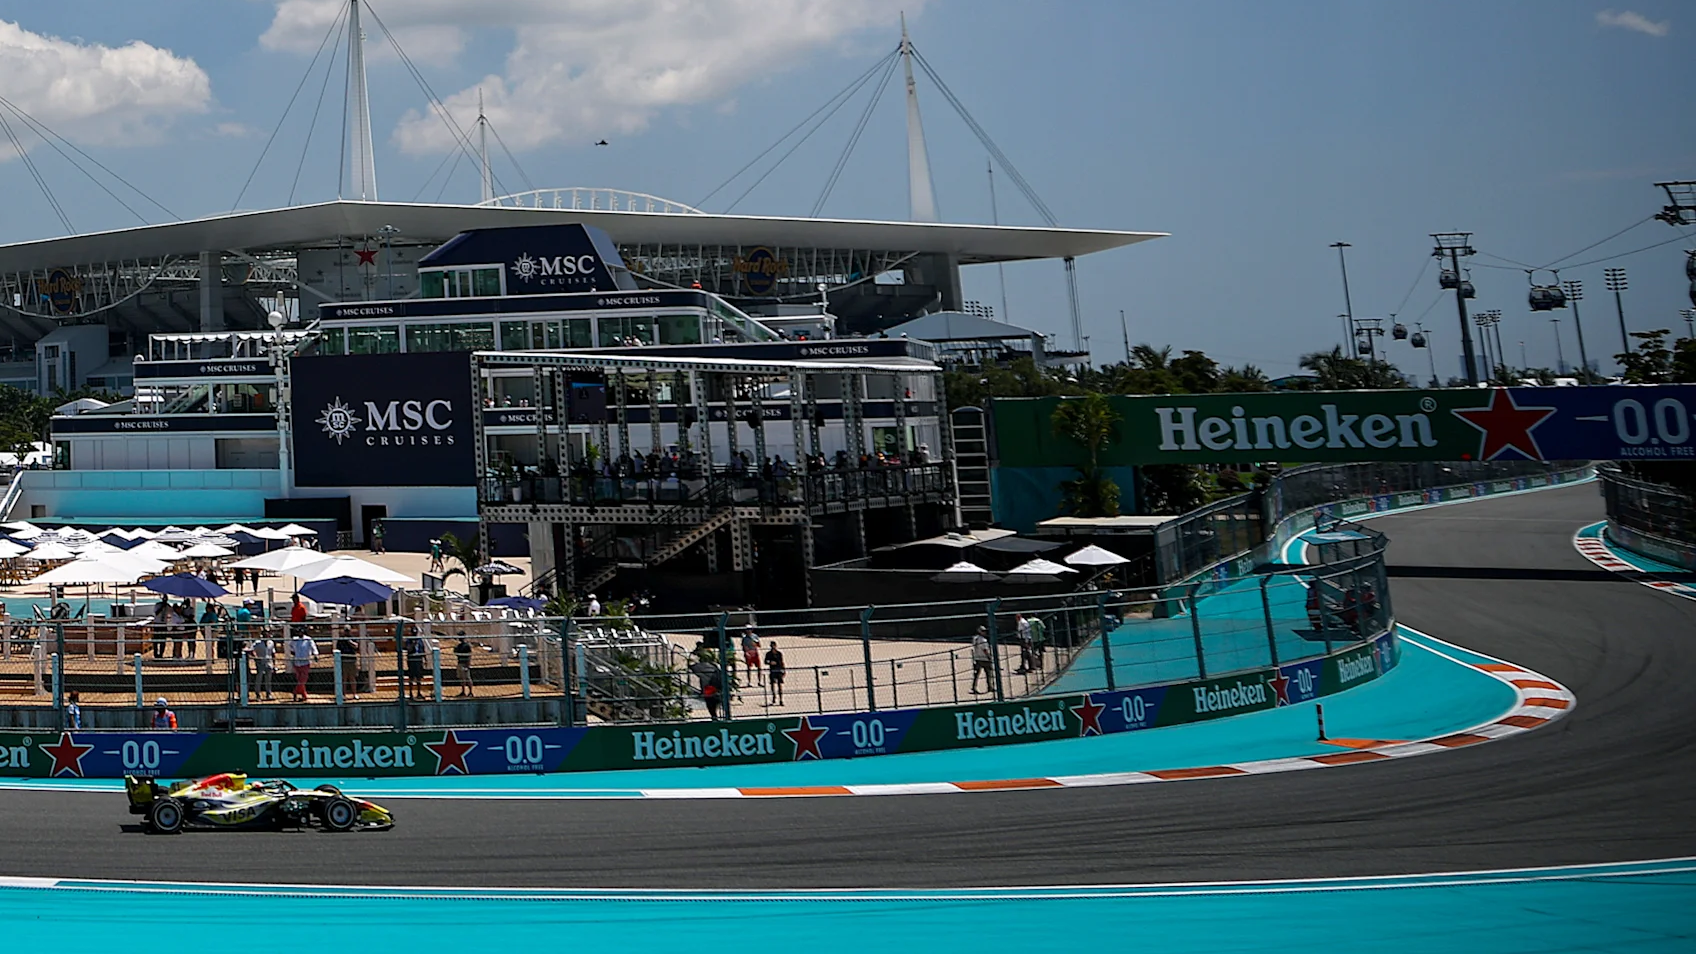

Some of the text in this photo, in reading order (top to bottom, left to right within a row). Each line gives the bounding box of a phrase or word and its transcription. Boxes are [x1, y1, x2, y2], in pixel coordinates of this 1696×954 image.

[539, 255, 595, 276] MSC
[540, 277, 597, 286] CRUISES
[605, 297, 661, 306] MSC CRUISES
[343, 307, 394, 316] MSC CRUISES
[809, 346, 869, 355] MSC CRUISES
[223, 365, 257, 373] CRUISES
[364, 400, 453, 431] MSC
[137, 421, 169, 429] CRUISES
[1154, 404, 1438, 451] Heineken
[366, 435, 455, 446] CRUISES
[1620, 446, 1695, 456] ALCOHOL FREE
[1337, 653, 1374, 683] Heineken
[1193, 681, 1267, 713] Heineken
[955, 707, 1066, 740] Heineken
[632, 729, 776, 760] Heineken
[256, 740, 415, 769] Heineken
[220, 806, 256, 822] VISA
